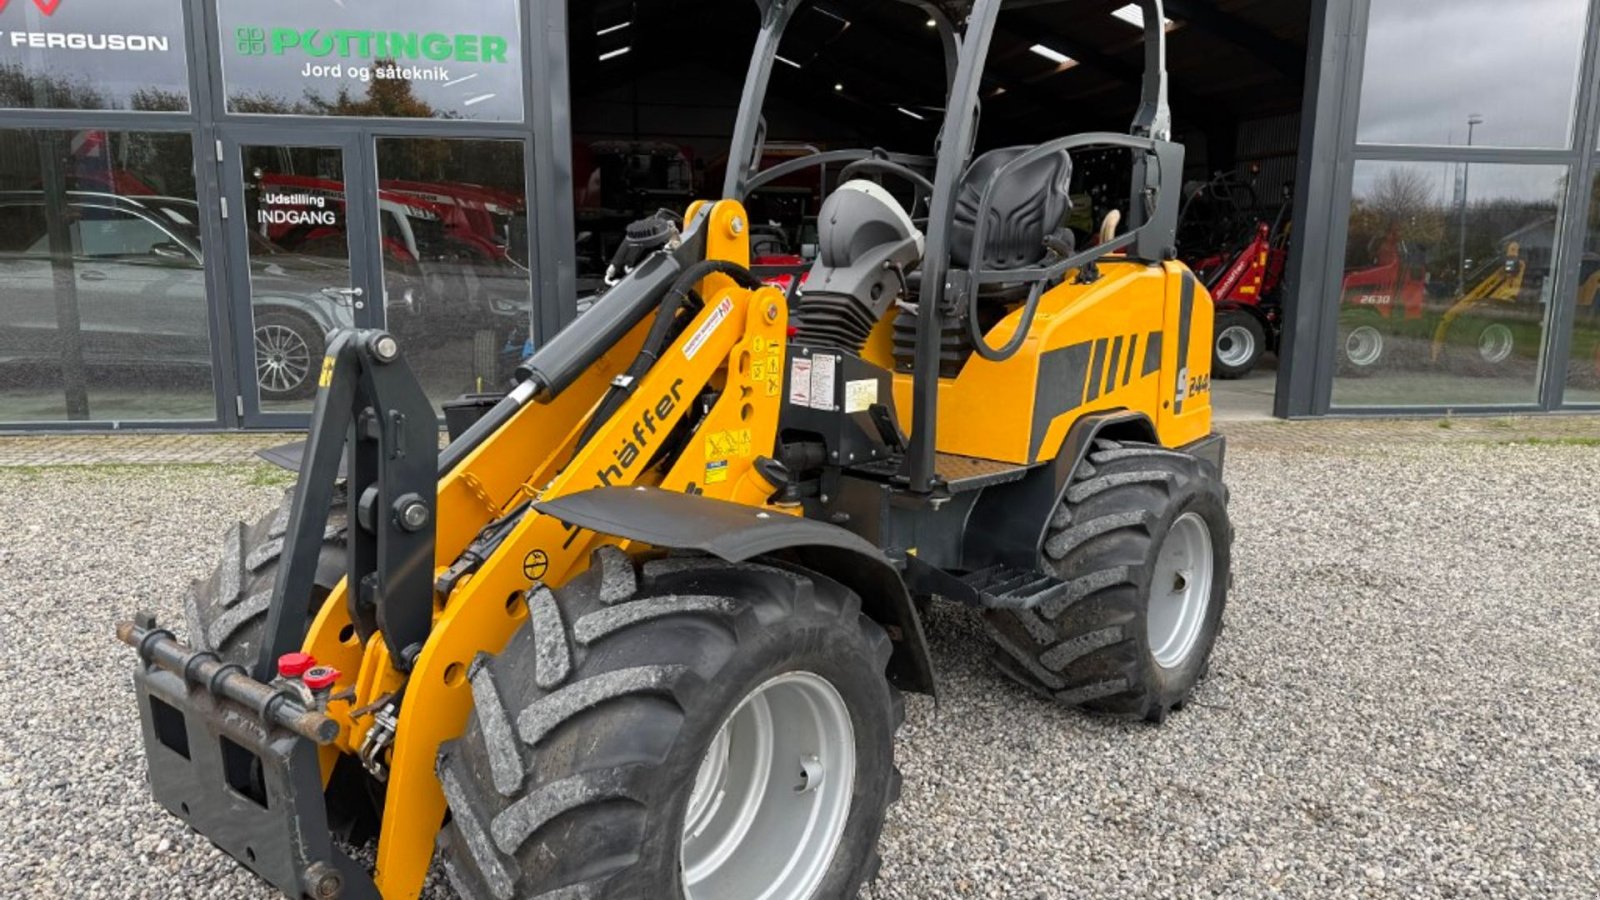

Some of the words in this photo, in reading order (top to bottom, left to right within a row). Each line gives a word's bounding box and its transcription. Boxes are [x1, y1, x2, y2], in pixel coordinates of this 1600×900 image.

[10, 31, 169, 51] FERGUSON
[301, 63, 342, 78] Jord
[347, 67, 371, 81] og
[375, 65, 449, 81] såteknik
[265, 193, 326, 208] Udstilling
[257, 209, 336, 225] INDGANG
[1359, 294, 1391, 305] 2630
[1188, 373, 1212, 399] 244
